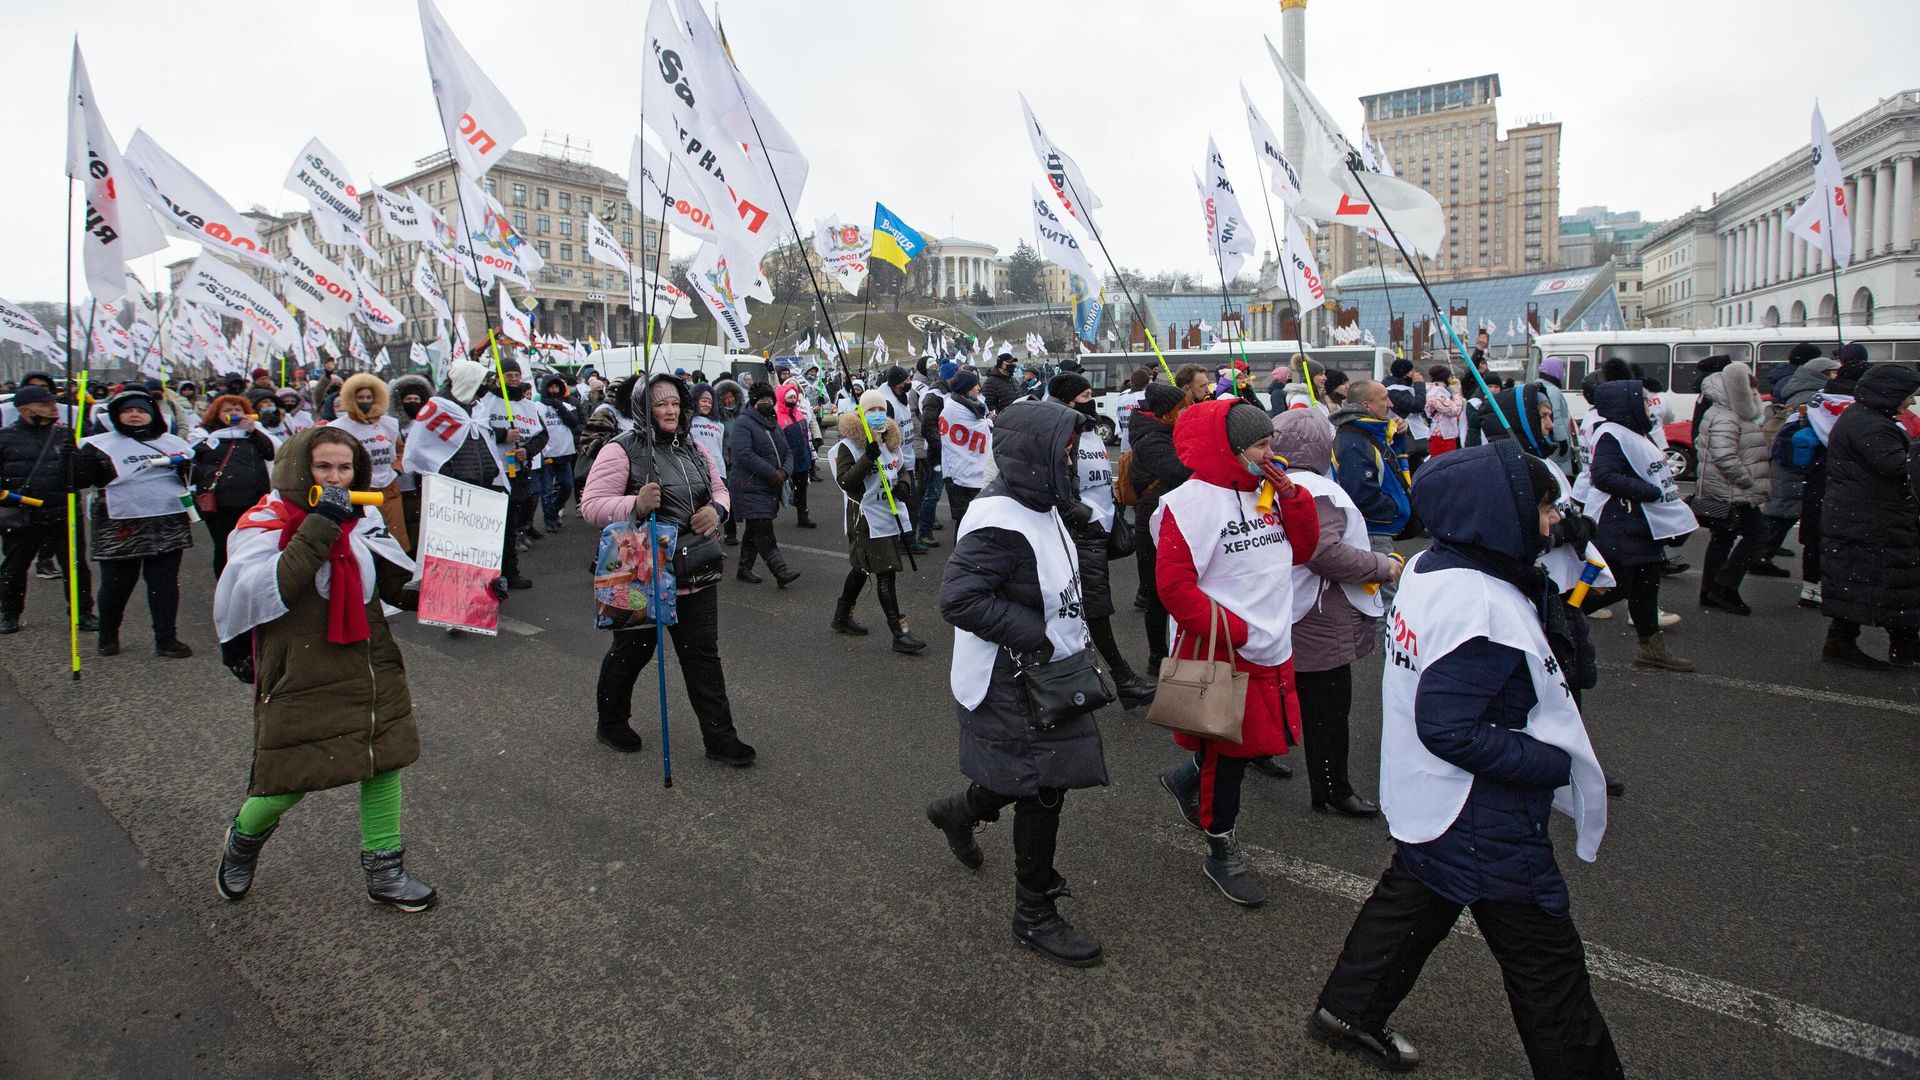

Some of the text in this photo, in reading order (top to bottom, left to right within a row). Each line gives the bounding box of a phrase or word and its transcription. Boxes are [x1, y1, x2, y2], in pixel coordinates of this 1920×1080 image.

[1515, 112, 1554, 126] HOTEL
[1538, 275, 1589, 292] GLOBUS
[426, 534, 502, 569] КАРАНТИНУ
